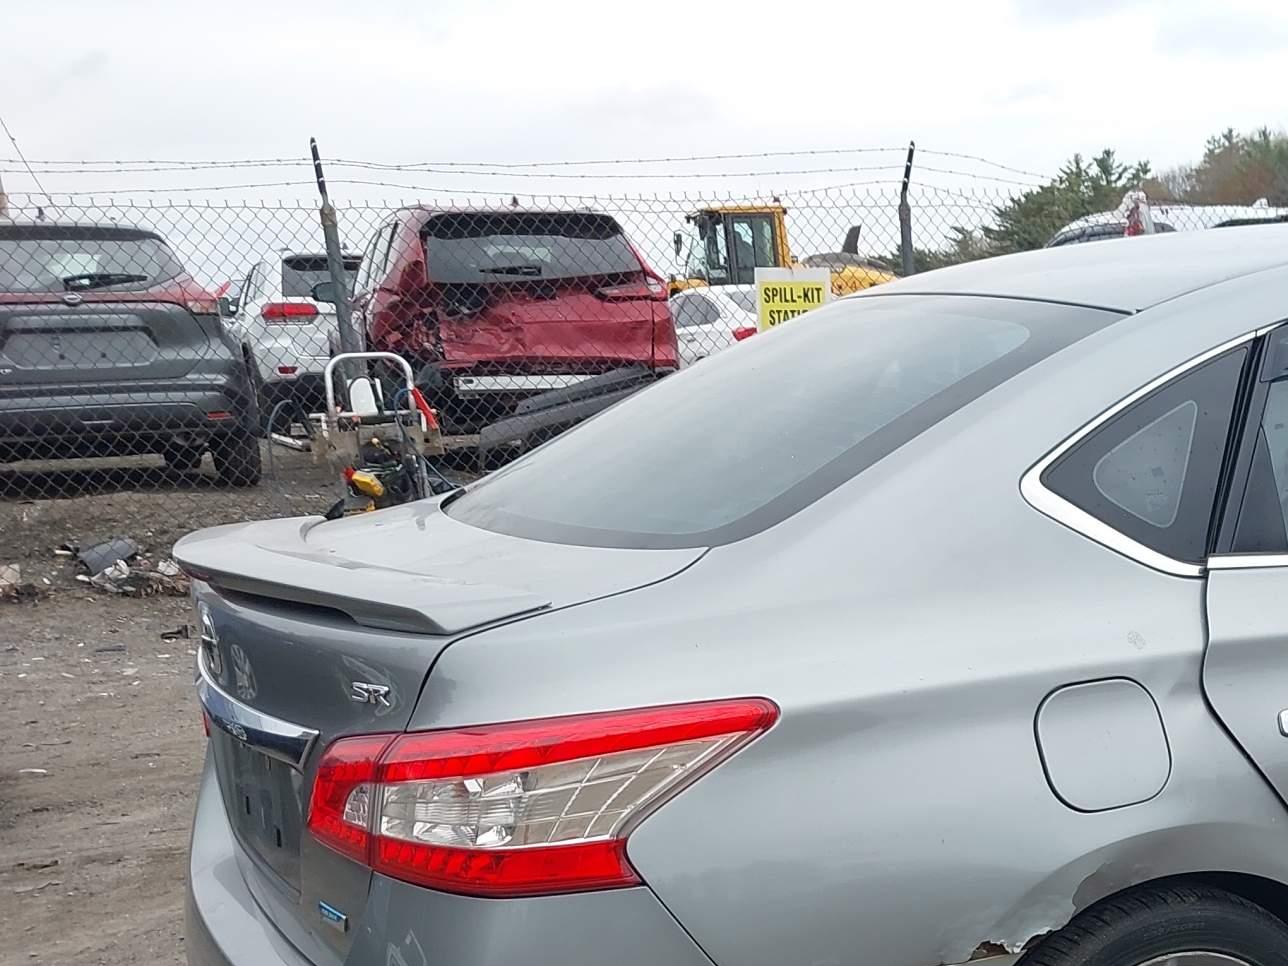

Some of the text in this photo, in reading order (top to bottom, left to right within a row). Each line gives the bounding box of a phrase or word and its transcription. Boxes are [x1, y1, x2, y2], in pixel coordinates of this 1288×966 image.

[763, 287, 822, 304] SPILL-KIT
[769, 309, 809, 326] STAT
[351, 681, 390, 706] SR
